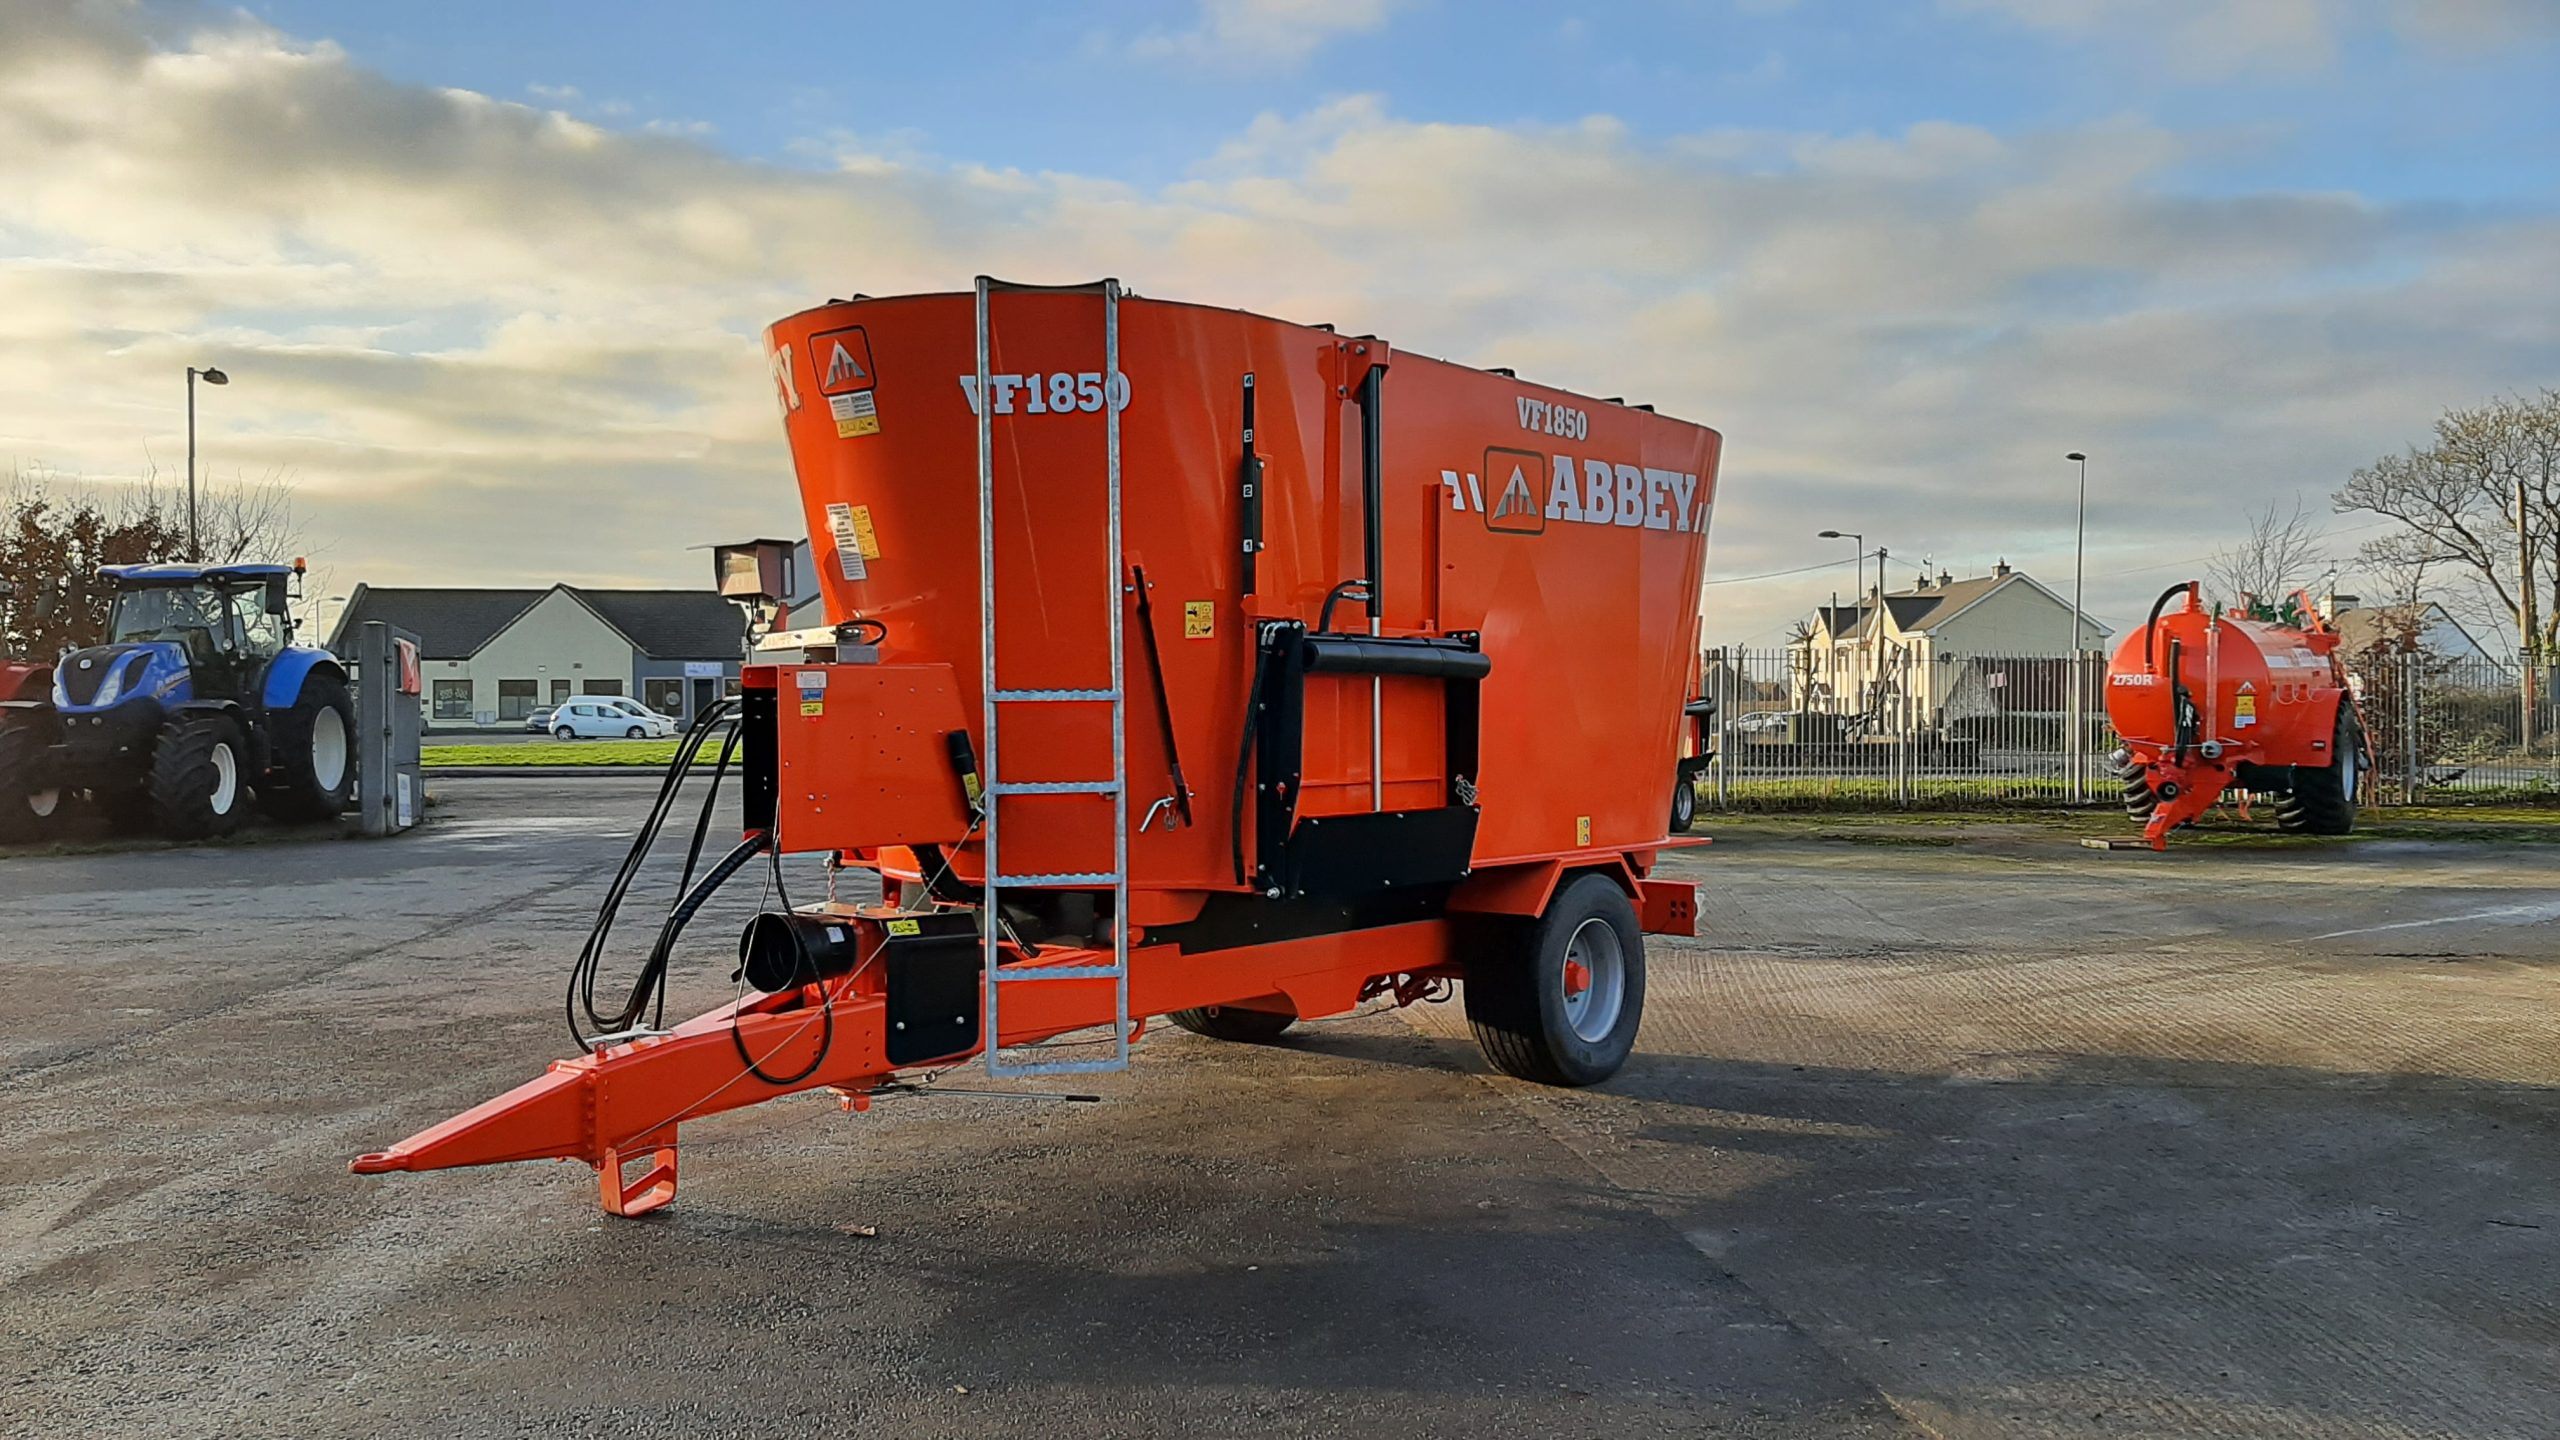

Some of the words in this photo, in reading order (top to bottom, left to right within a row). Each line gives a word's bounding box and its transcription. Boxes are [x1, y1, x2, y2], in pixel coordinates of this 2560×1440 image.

[1517, 396, 1587, 440] VF1850
[1545, 455, 1696, 532] ABBEY
[2112, 674, 2153, 686] 2750R
